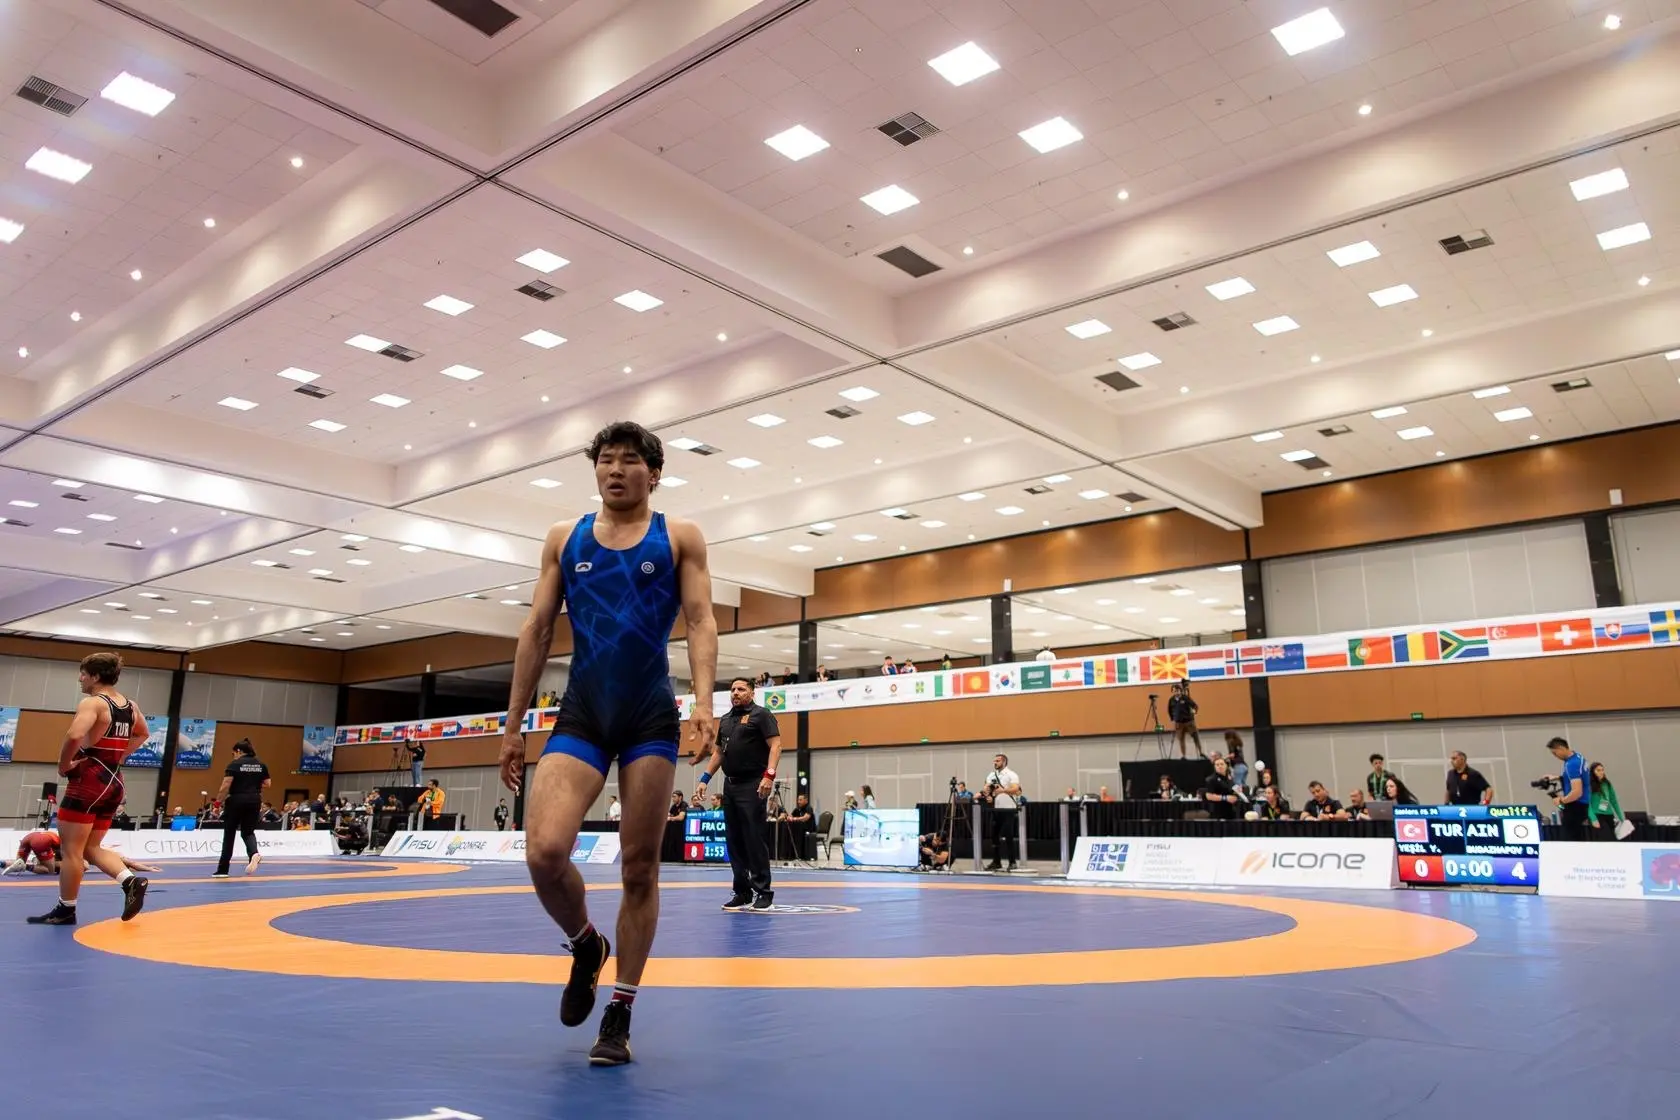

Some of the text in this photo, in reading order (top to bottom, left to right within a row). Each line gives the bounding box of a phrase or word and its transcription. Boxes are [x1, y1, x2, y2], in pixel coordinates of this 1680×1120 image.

[115, 721, 129, 737] TUR
[1458, 807, 1467, 817] 2
[1490, 807, 1533, 817] Qualif.
[701, 822, 715, 831] FRA
[716, 822, 726, 831] CA
[1430, 823, 1463, 837] TUR
[1466, 823, 1499, 837] AIN
[408, 839, 437, 850] FISU
[691, 845, 698, 858] 8
[704, 846, 724, 857] 1:53
[1414, 859, 1429, 877] 0
[1446, 860, 1493, 877] 0:00
[1511, 861, 1527, 880] 4
